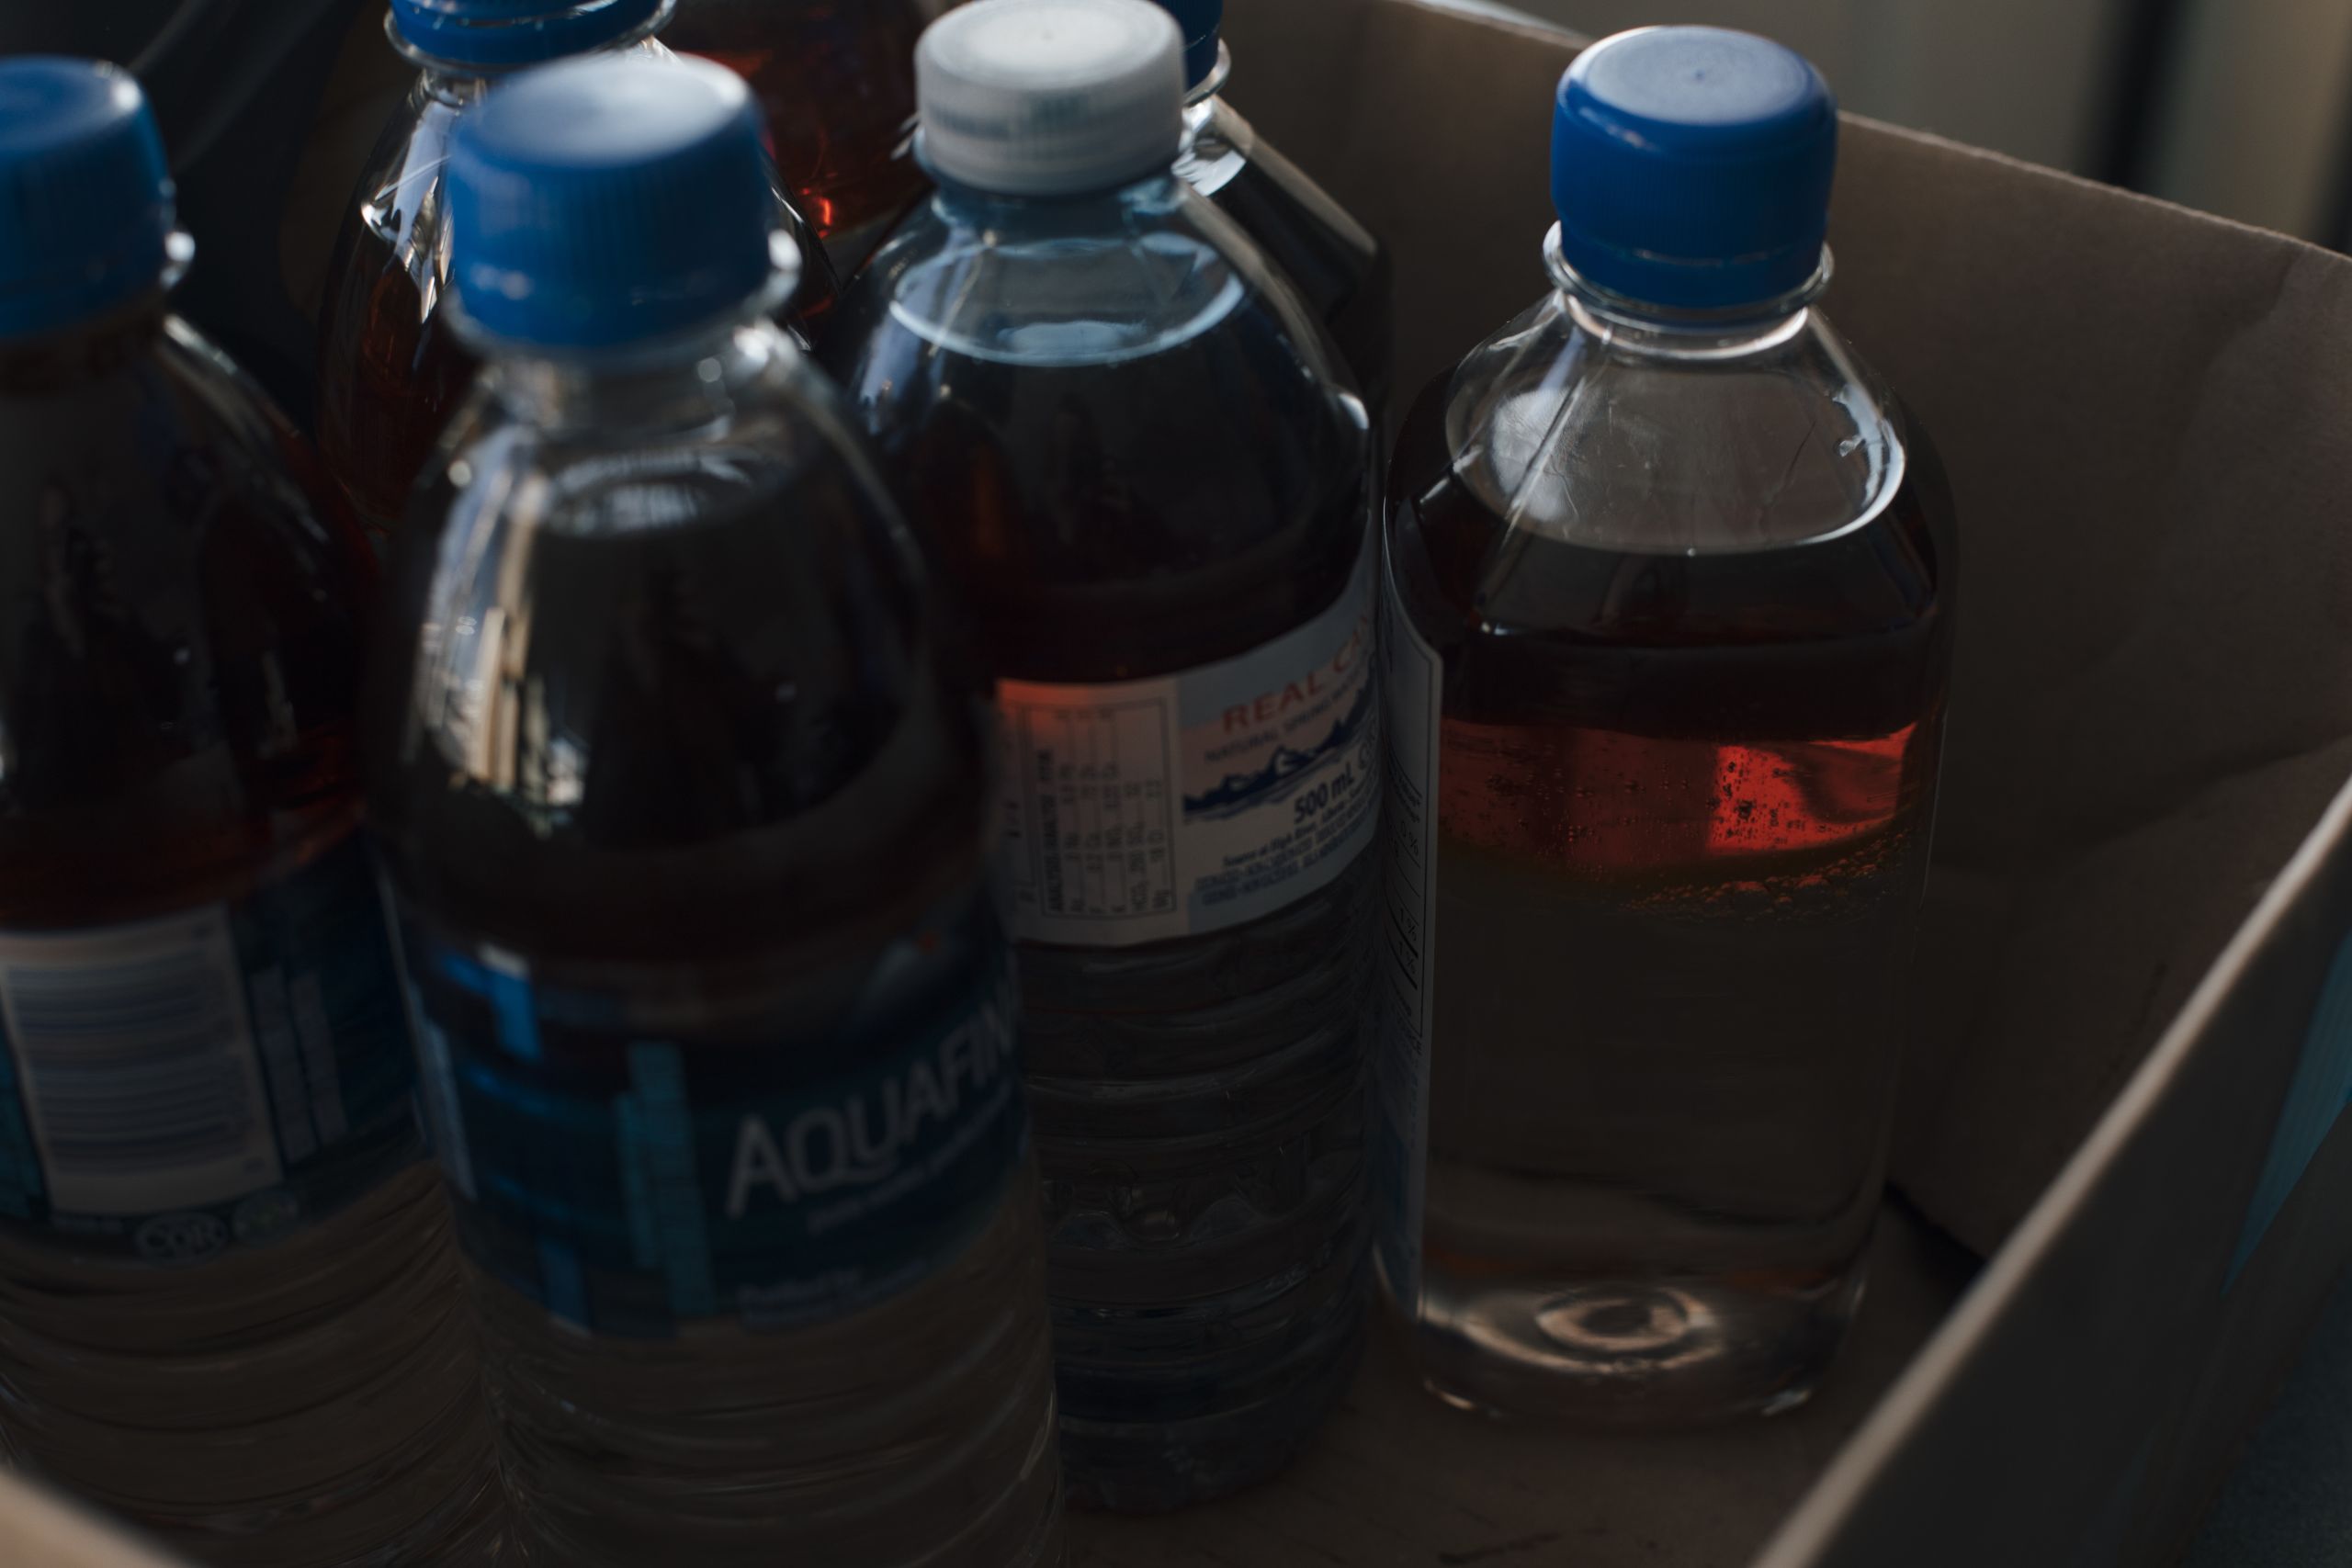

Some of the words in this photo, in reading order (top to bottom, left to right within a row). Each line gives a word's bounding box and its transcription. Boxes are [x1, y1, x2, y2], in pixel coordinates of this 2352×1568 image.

[1204, 729, 1278, 763] NATURAL
[1283, 698, 1331, 733] SPRING
[1224, 671, 1322, 734] REAL
[1294, 782, 1328, 825] 500
[1331, 761, 1353, 800] mL
[724, 972, 1020, 1218] AQUAFIN
